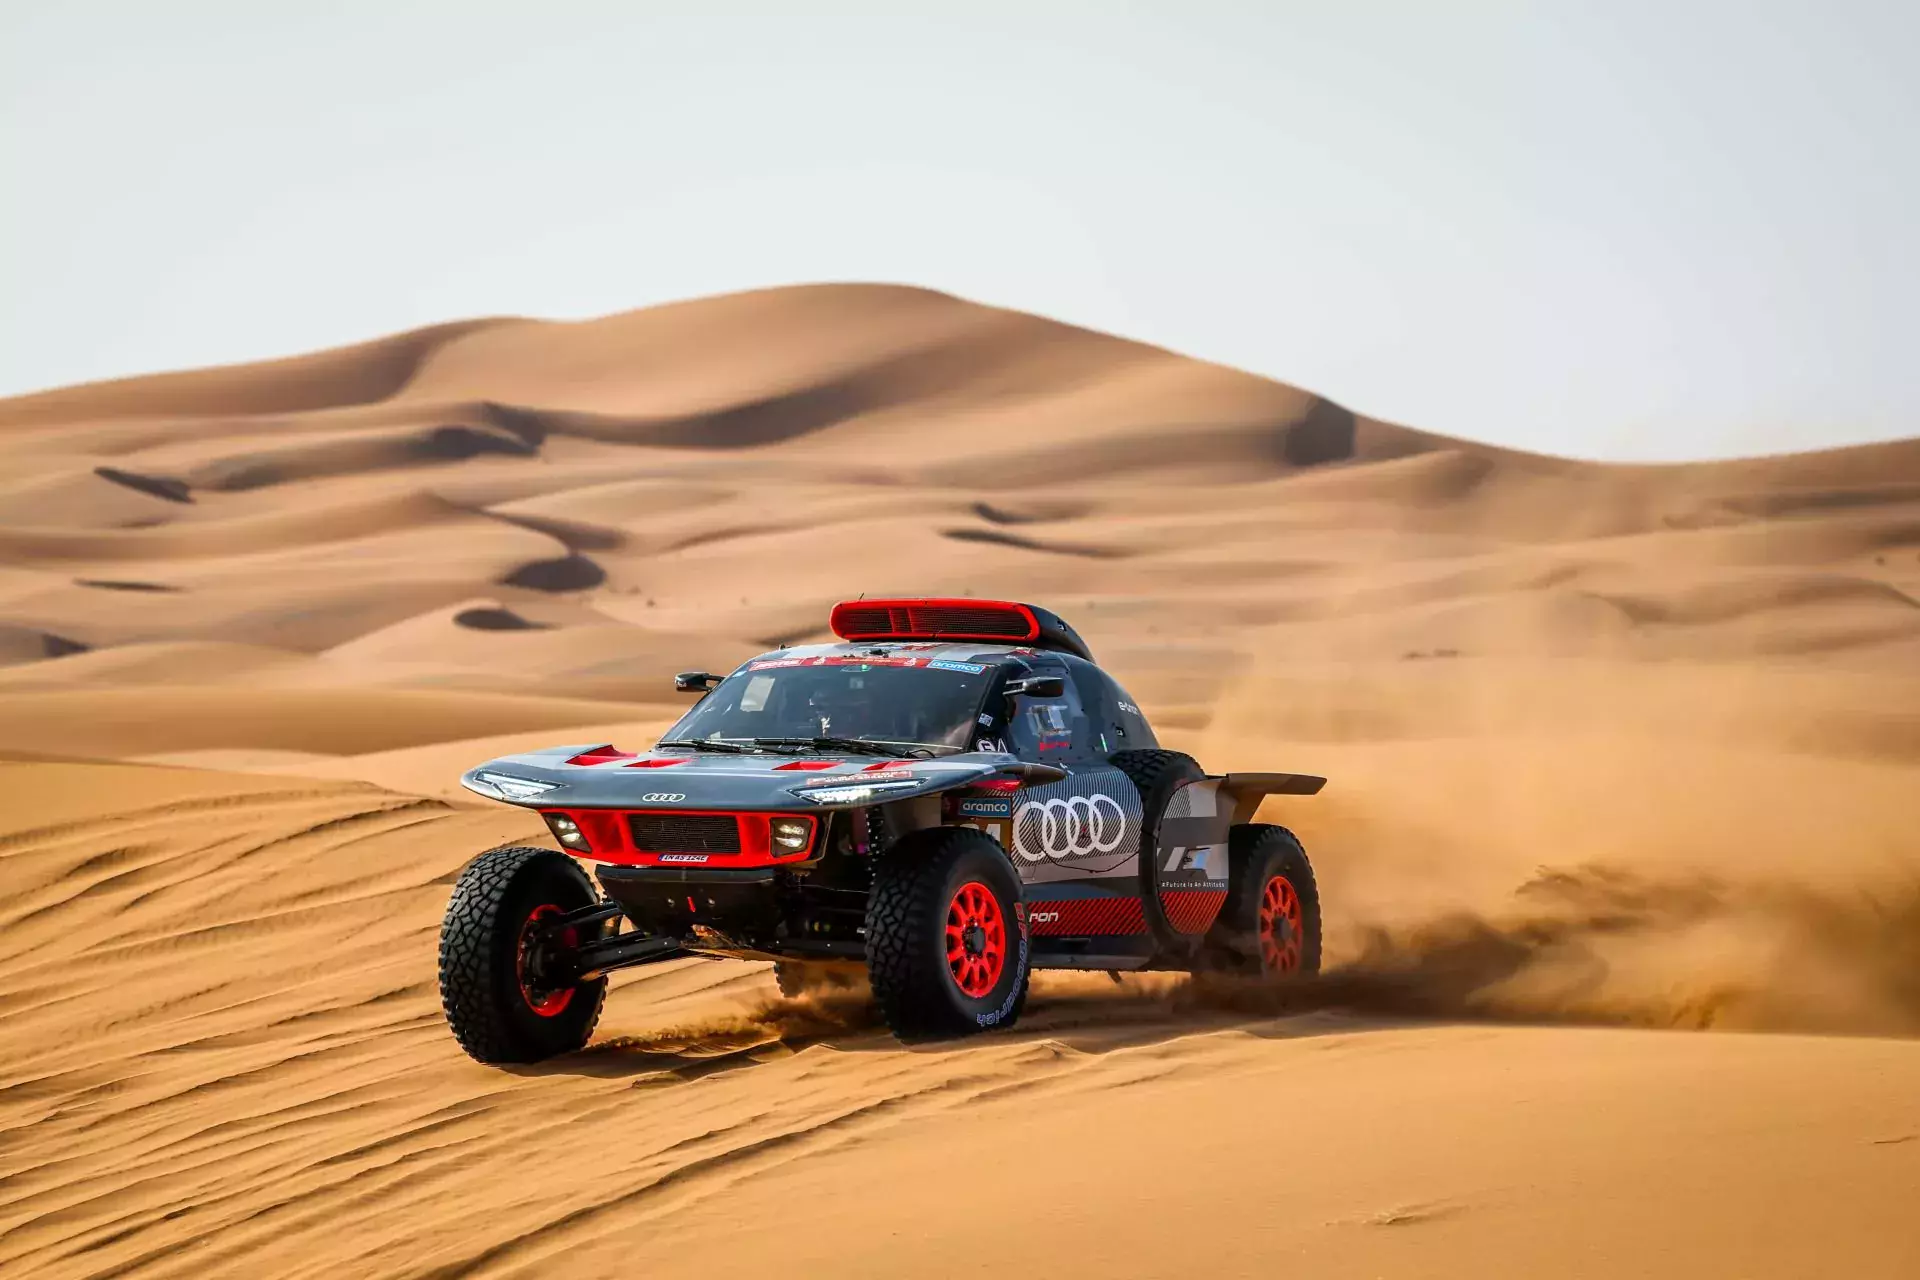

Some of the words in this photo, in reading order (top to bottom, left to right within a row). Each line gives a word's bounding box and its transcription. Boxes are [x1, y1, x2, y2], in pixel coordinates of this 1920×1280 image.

[932, 660, 979, 671] aramco
[962, 803, 1008, 812] aramco
[1029, 912, 1059, 922] ron
